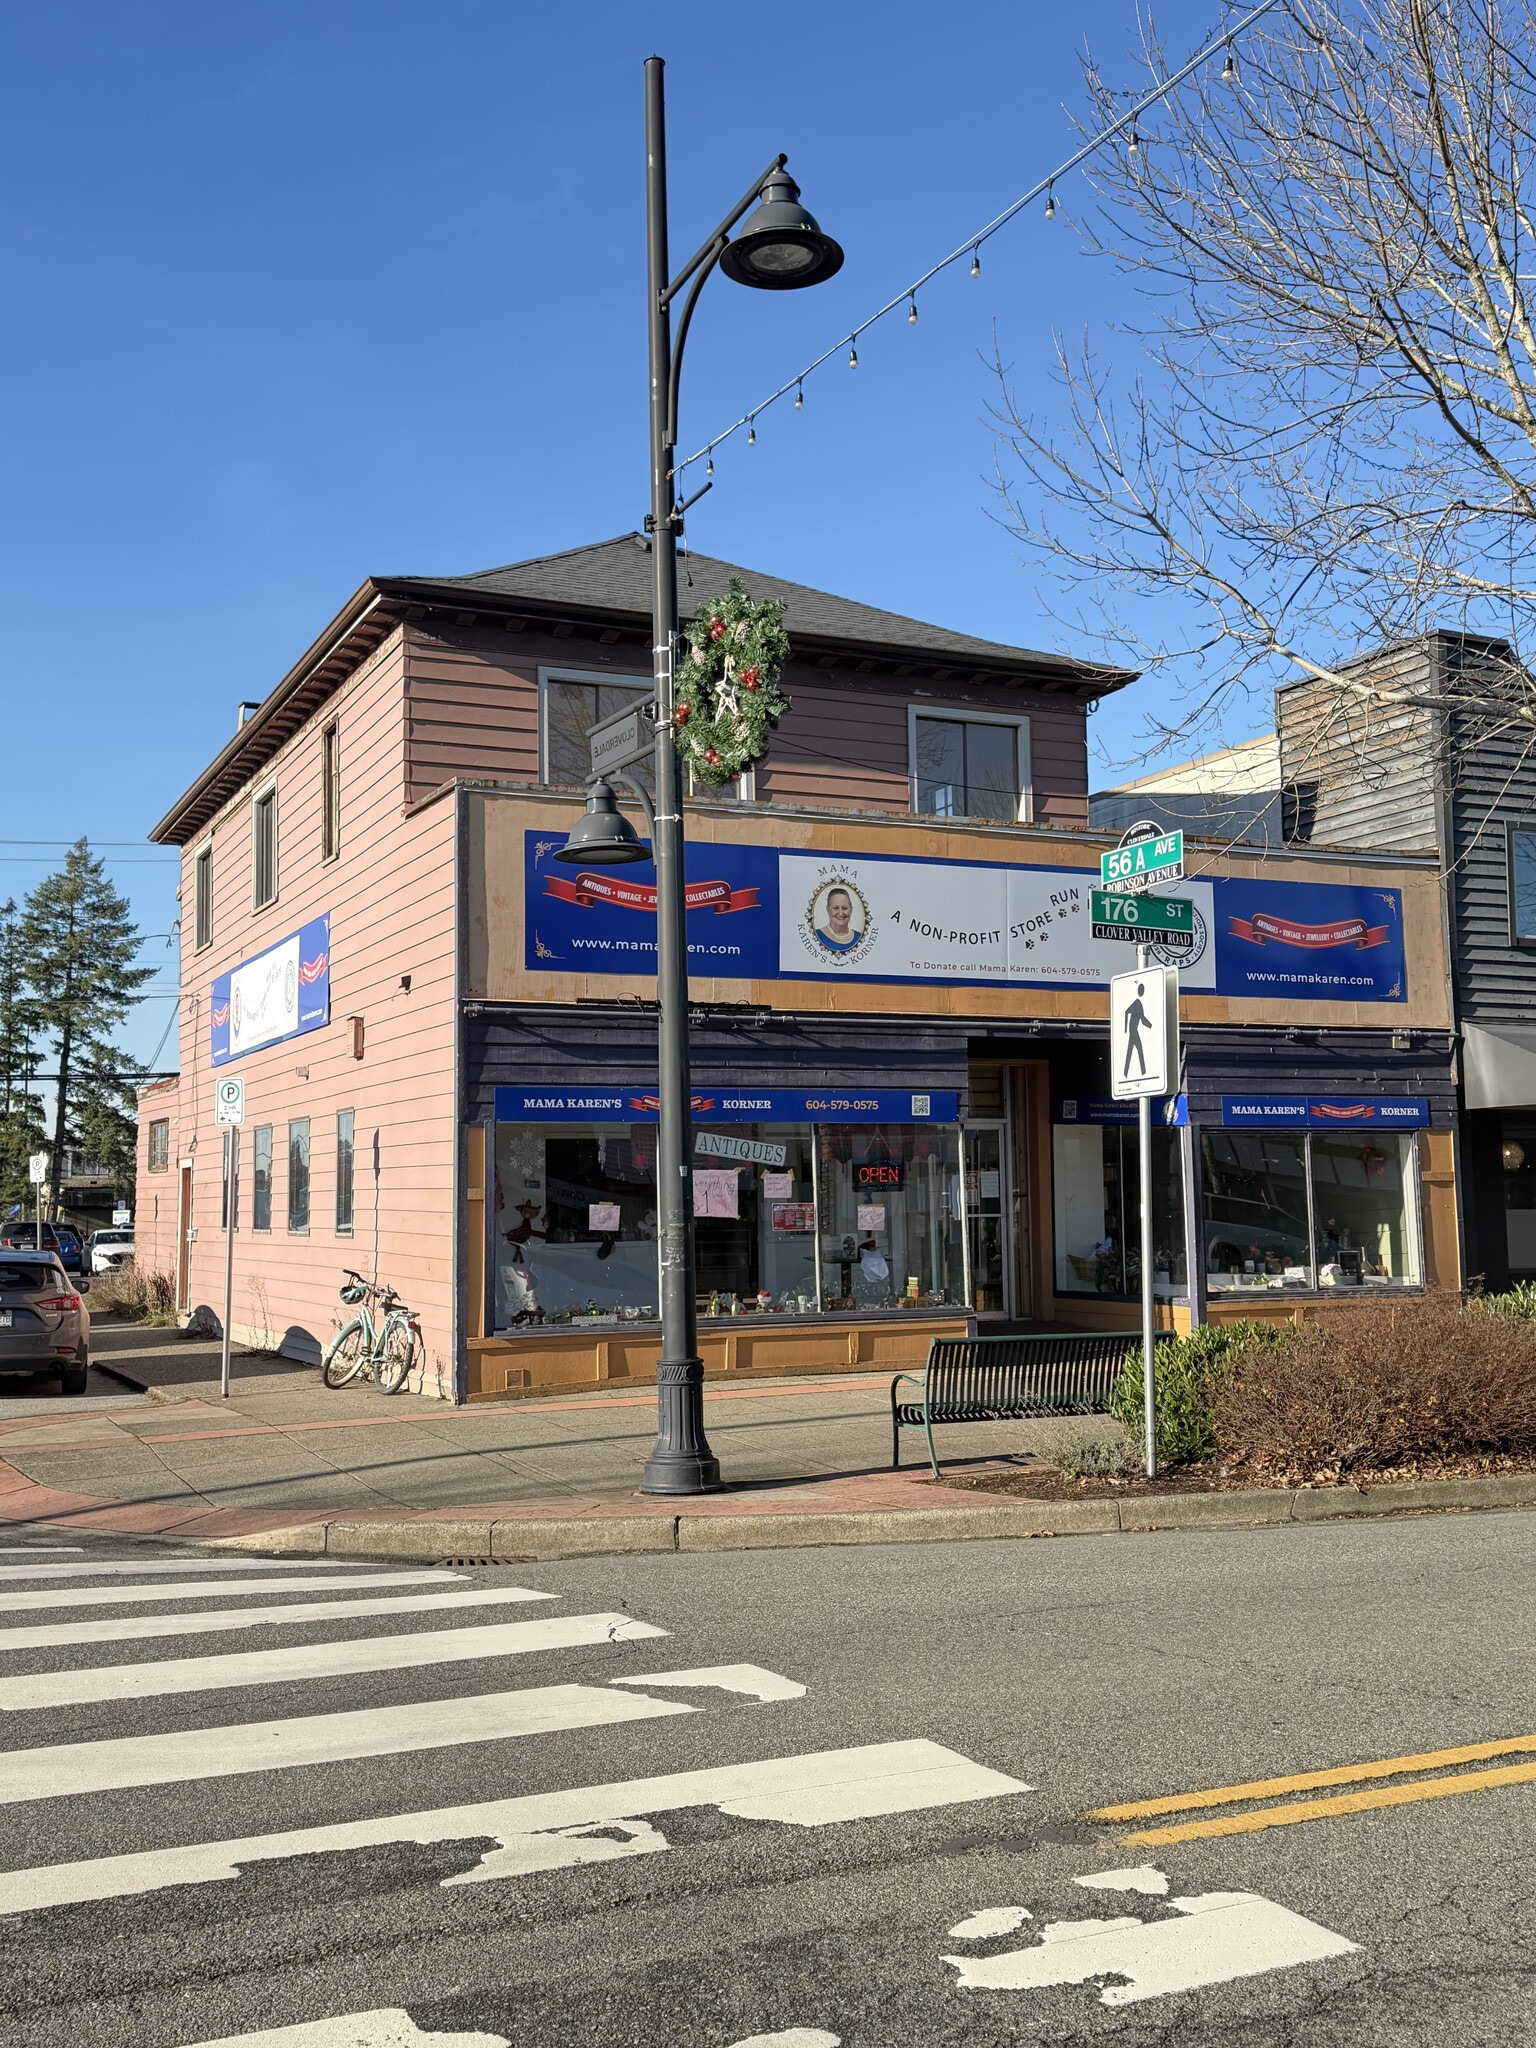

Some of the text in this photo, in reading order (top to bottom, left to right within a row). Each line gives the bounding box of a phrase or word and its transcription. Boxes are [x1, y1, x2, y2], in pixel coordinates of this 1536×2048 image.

[1108, 837, 1177, 878] 56 A AVE
[818, 864, 858, 879] MAMA
[1106, 865, 1178, 892] ROBINSON AVENUE
[582, 879, 611, 896] ANTIQUES
[617, 890, 642, 902] VINTAGE
[686, 886, 726, 903] COLLECTABLES
[890, 888, 1079, 945] A NON-PROFIT STORE RUN
[1101, 897, 1184, 923] 176 ST
[1095, 925, 1191, 946] CLOVER VALLEY ROAD
[1256, 919, 1364, 941] ANTIQUES VINTAGE JEWELLERY COLLECTABLES
[798, 923, 828, 964] KAREN'S
[850, 927, 879, 965] KORNER
[1194, 930, 1205, 957] SOCIETY
[910, 961, 1100, 976] To Donate call Mama Karen: 604-579-0575
[1164, 955, 1191, 967] RAPS
[1246, 972, 1374, 986] www.mamakaren.com
[523, 1098, 879, 1110] MAMA KAREN'S KORNER 604-579-0575
[1231, 1106, 1420, 1116] MAMA KAREN'S KORNER
[698, 1136, 784, 1163] ANTIQUES
[858, 1166, 899, 1184] OPEN
[694, 1177, 735, 1195] verything
